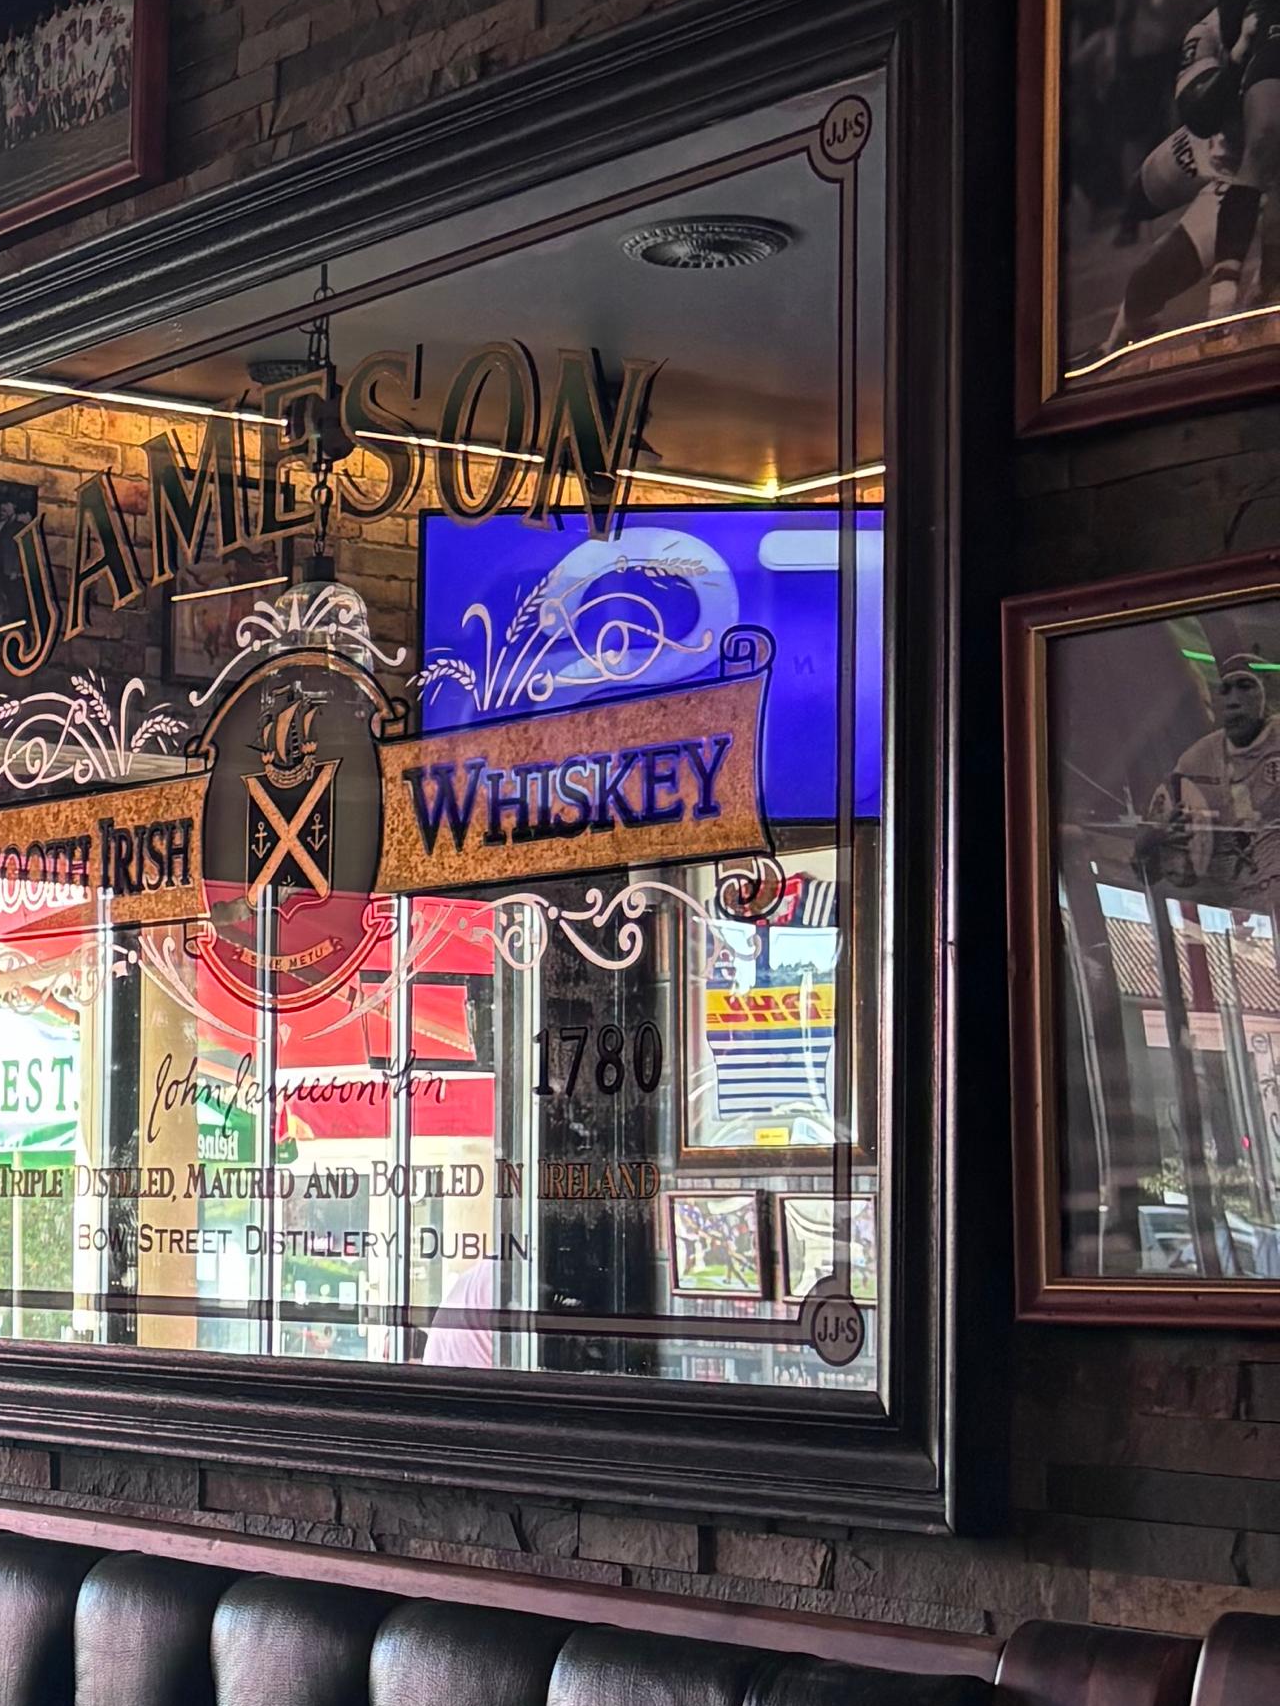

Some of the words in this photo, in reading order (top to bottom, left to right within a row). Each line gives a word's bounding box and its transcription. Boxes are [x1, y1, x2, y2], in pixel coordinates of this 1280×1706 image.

[2, 339, 662, 678] JAMESON
[97, 817, 194, 900] IRISH
[402, 733, 733, 857] WHISKEY
[251, 955, 283, 970] SE
[0, 1055, 80, 1113] EST.
[532, 1020, 664, 1097] 1780
[147, 1052, 222, 1143] John
[183, 1162, 295, 1200] MATURED
[303, 1161, 359, 1199] AND
[371, 1159, 485, 1200] BOTTLED
[494, 1158, 525, 1200] IN
[536, 1158, 661, 1200] IRELAND
[78, 1223, 130, 1253] BOW
[139, 1223, 232, 1254] STREET
